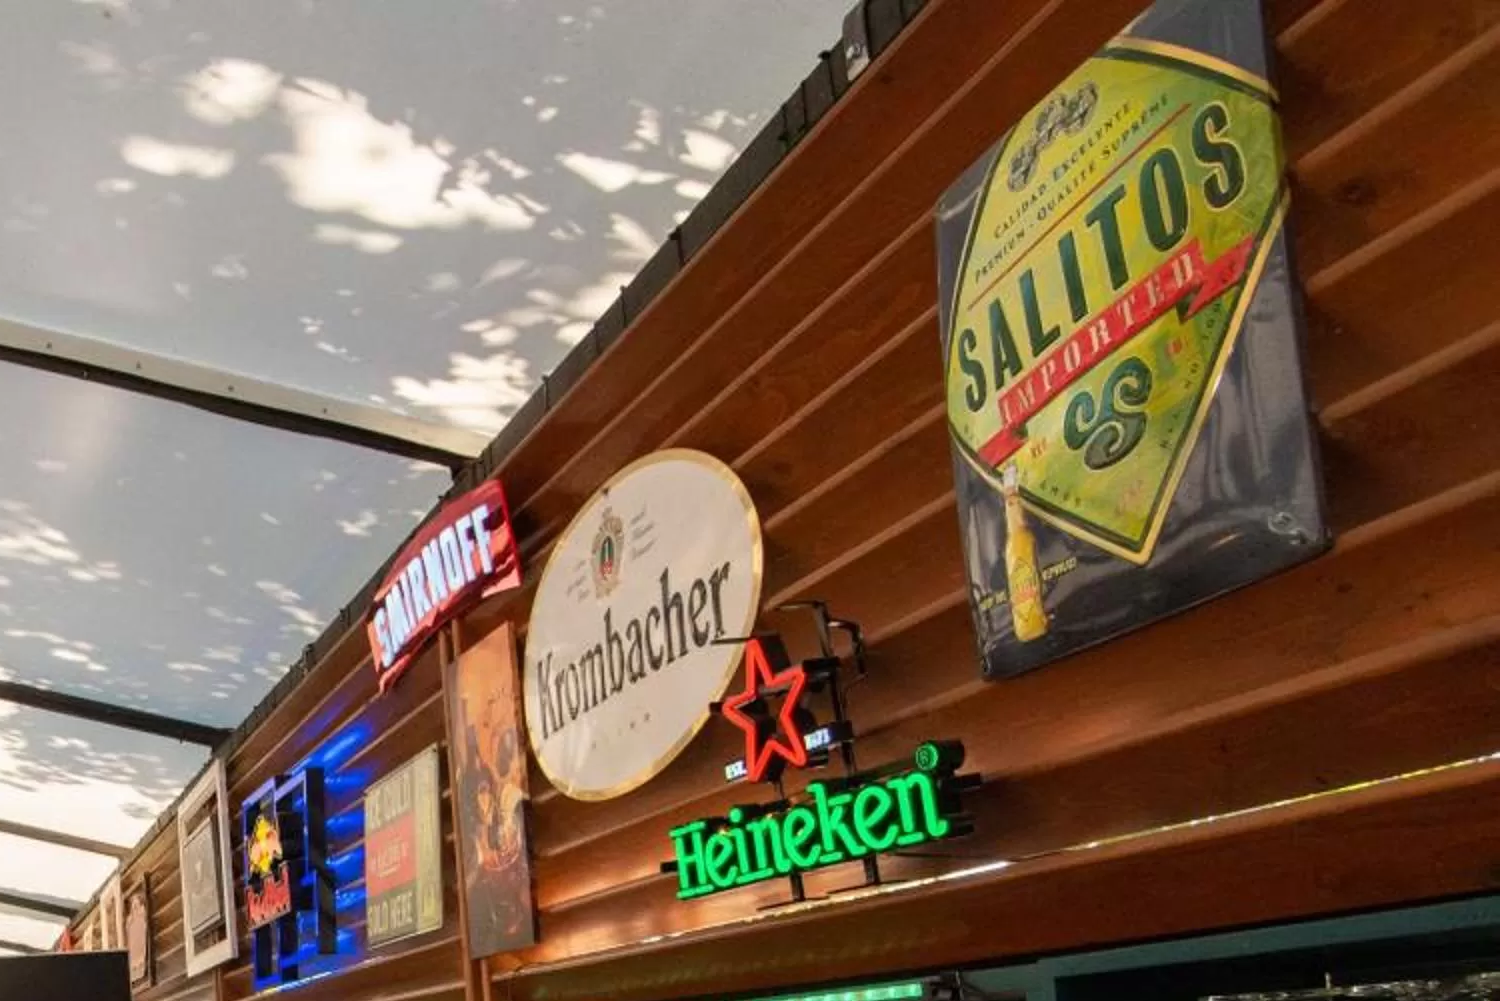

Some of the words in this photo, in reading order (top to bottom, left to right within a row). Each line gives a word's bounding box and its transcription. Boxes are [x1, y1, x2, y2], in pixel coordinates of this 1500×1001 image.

[957, 99, 1245, 413] SALITOS
[974, 230, 1025, 284] PREMIUM
[994, 184, 1048, 240] CALIDAD
[1000, 251, 1197, 427] IMPORTED
[373, 504, 493, 668] SMIRNOFF
[537, 560, 730, 740] Krombacher
[669, 771, 948, 900] Heineken
